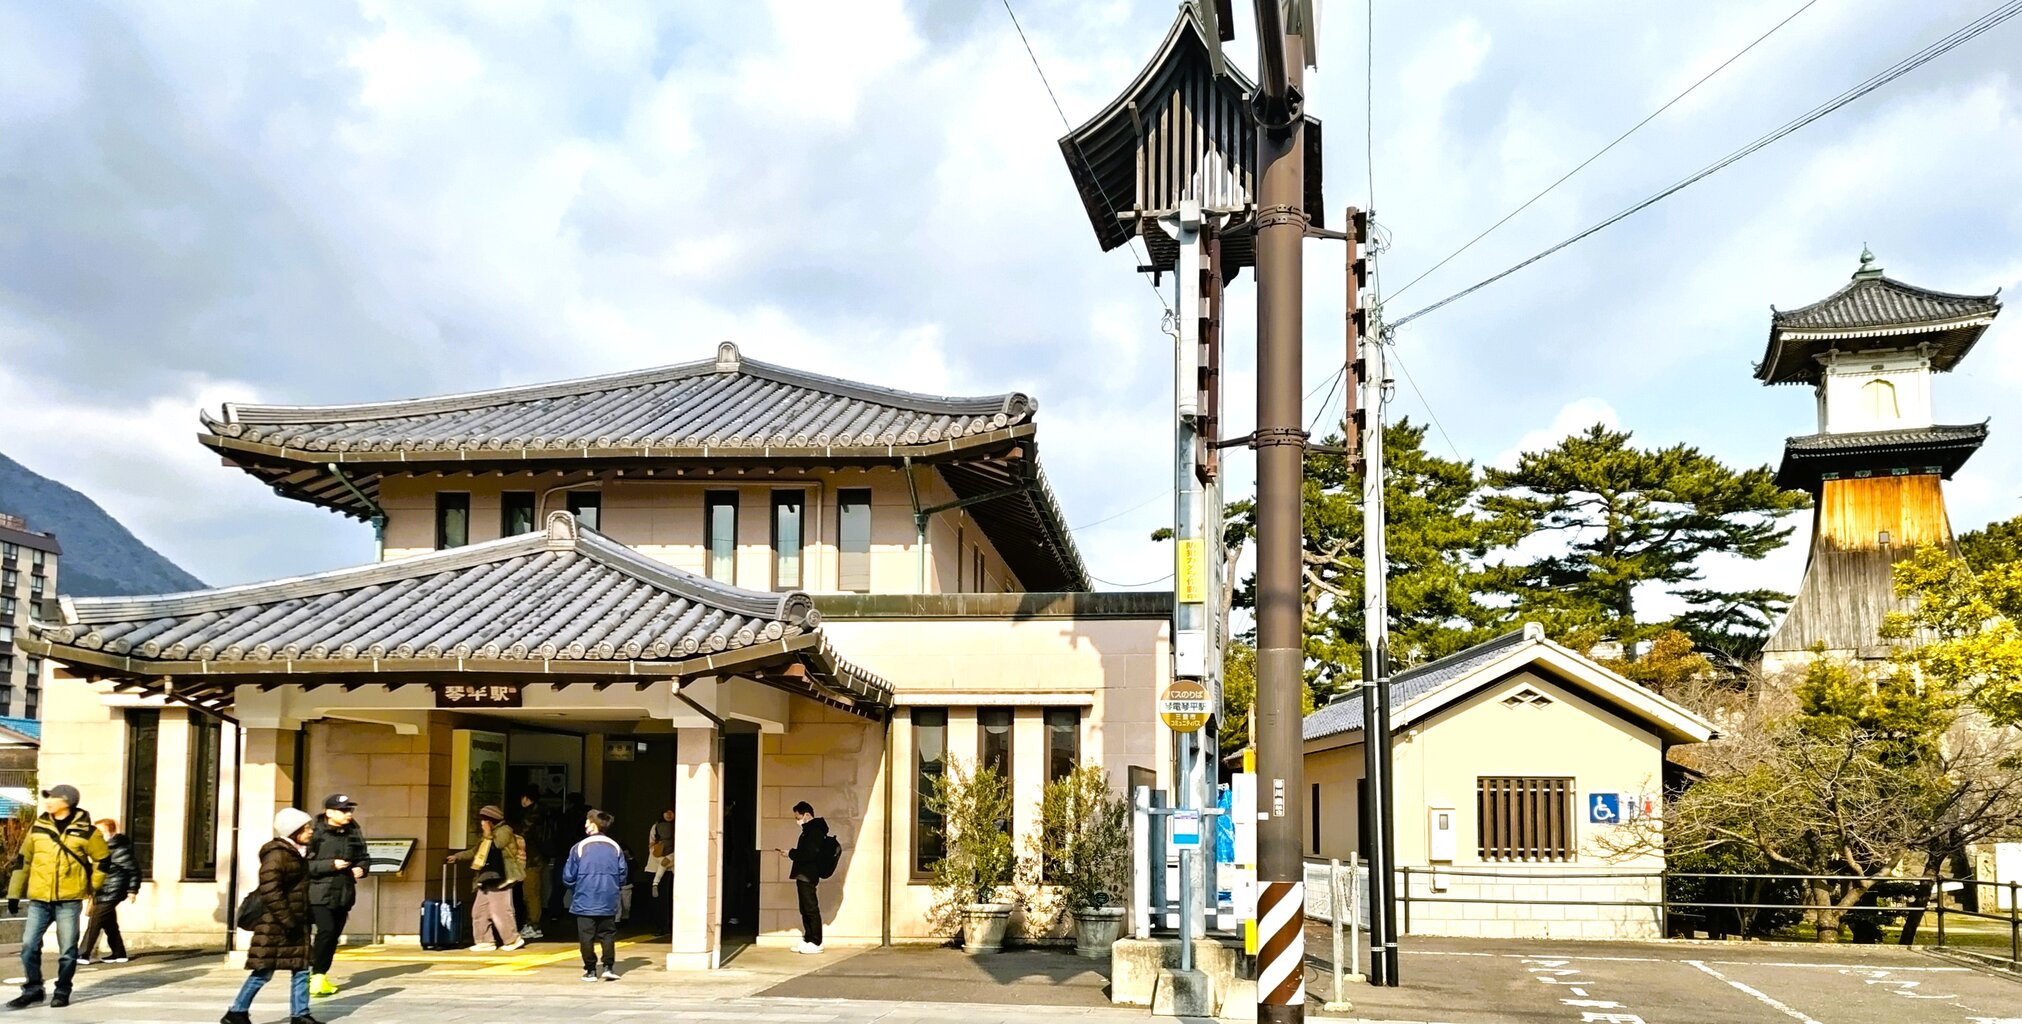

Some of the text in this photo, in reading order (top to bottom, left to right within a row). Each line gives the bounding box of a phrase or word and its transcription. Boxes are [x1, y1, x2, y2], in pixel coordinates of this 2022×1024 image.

[444, 685, 510, 702] 琴平駅
[1165, 690, 1204, 699] バスのりば
